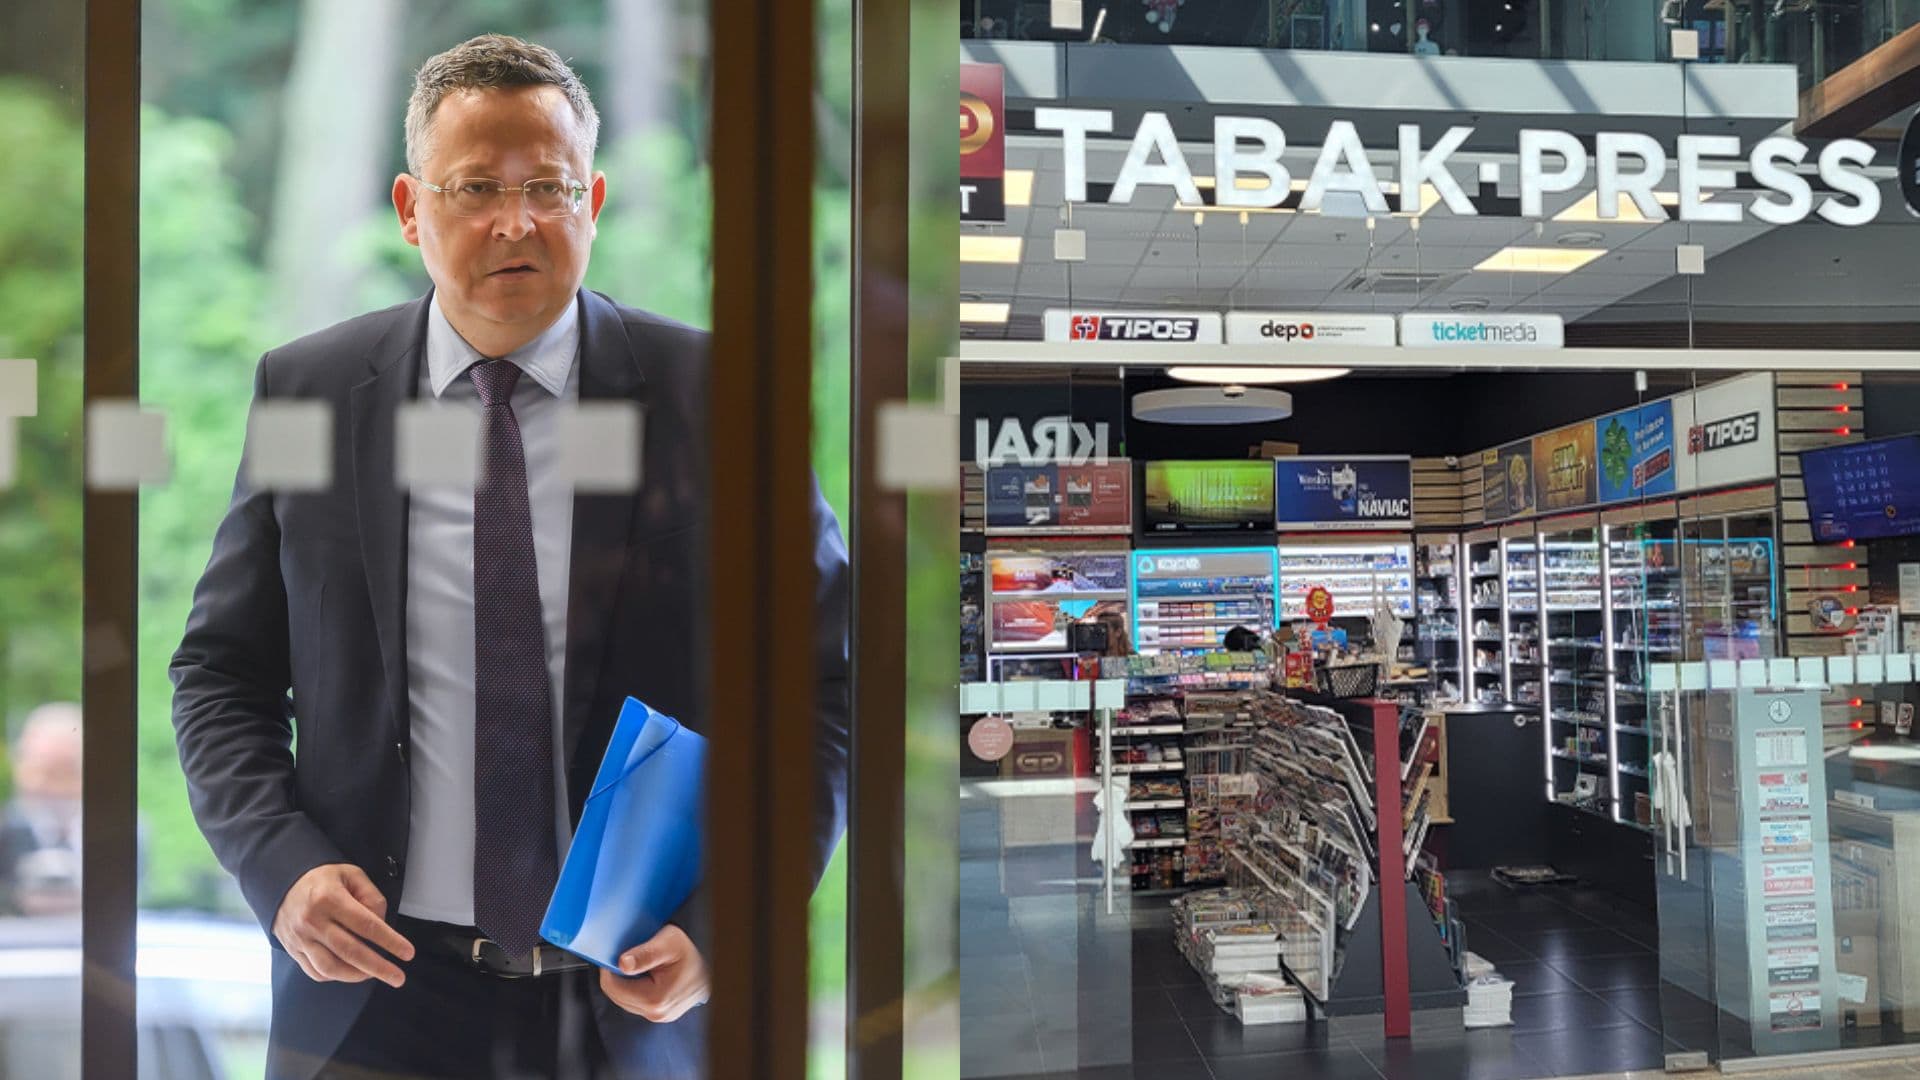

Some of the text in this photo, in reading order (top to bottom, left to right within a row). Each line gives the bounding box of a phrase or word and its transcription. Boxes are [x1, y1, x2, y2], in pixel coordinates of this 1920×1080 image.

[1106, 319, 1193, 338] TIPOS
[1432, 320, 1536, 341] ticketmedia
[1706, 413, 1756, 446] TIPOS
[1357, 498, 1410, 517] NAVIAC
